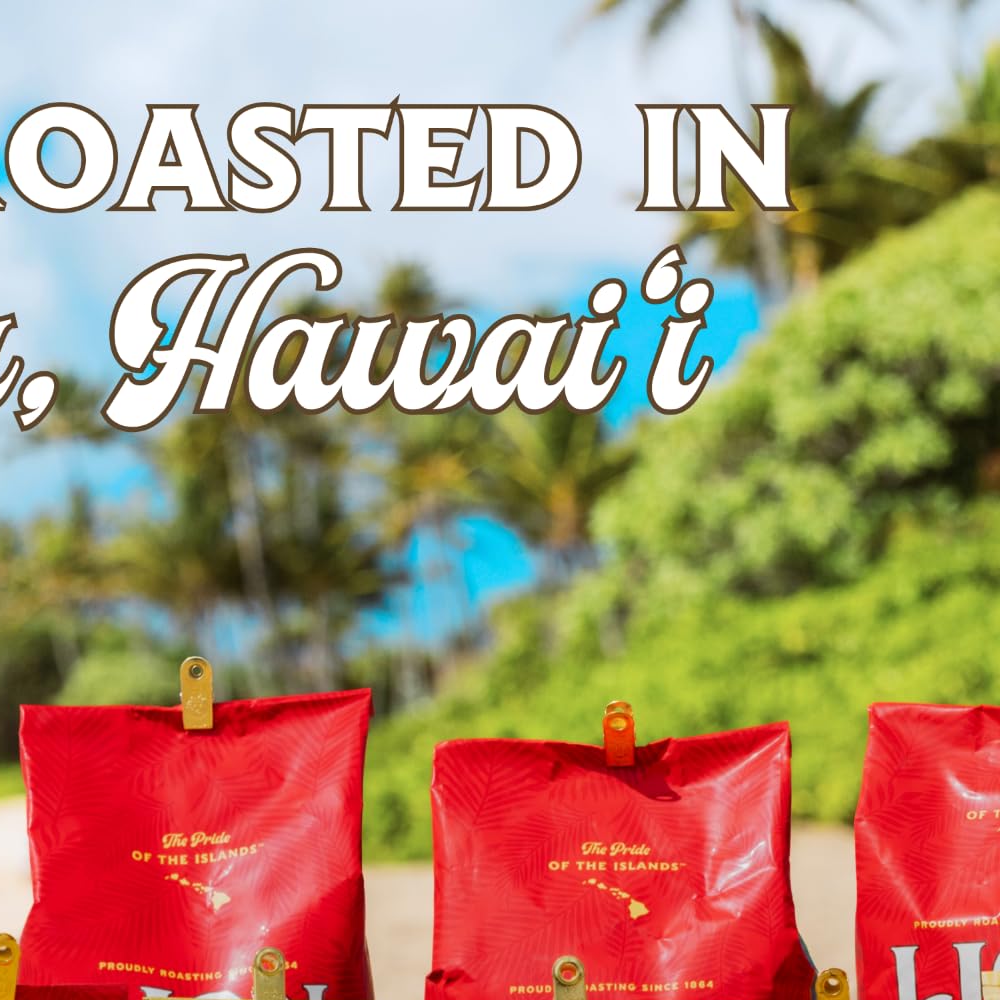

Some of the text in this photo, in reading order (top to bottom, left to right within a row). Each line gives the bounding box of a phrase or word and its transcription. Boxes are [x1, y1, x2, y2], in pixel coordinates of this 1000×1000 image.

[966, 810, 986, 820] OF
[163, 832, 231, 849] The Pride
[581, 842, 651, 855] The Pride
[132, 850, 152, 863] OF
[157, 852, 188, 865] THE
[548, 861, 569, 870] OF
[576, 861, 606, 870] THE
[914, 920, 969, 928] PROUDLY
[99, 961, 155, 975] PROUDLY
[160, 969, 222, 981] ROASTING
[510, 980, 713, 994] PROUD SINCE 1864
